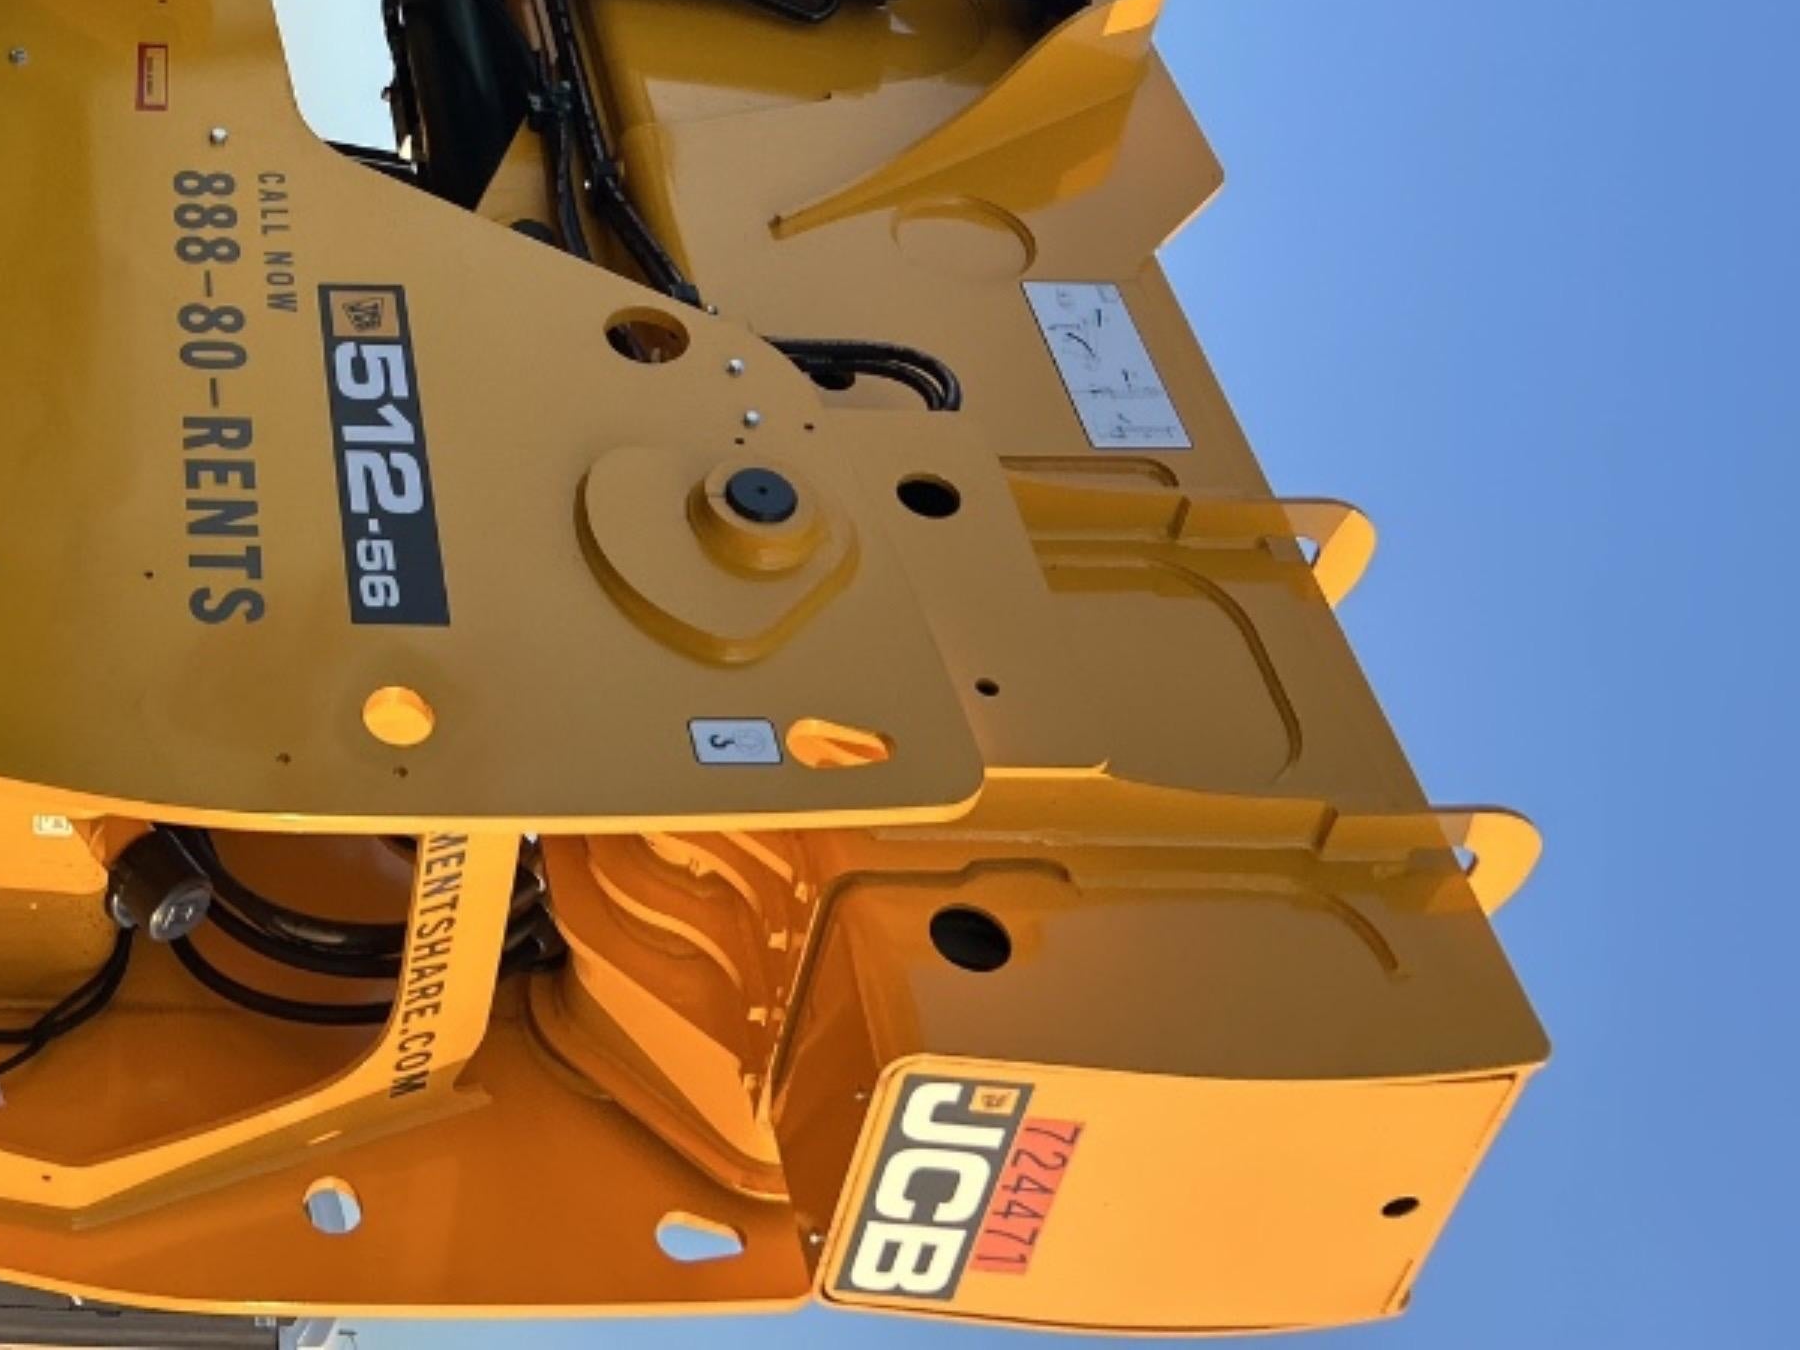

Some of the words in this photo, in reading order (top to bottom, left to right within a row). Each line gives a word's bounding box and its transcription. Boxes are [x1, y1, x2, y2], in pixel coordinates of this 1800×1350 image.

[257, 171, 292, 237] CALL
[264, 250, 298, 314] NOW
[173, 169, 265, 625] 888-80-RENTS
[333, 340, 425, 608] 512-56
[850, 1081, 1005, 1294] JCB
[973, 1126, 1081, 1265] 724471
